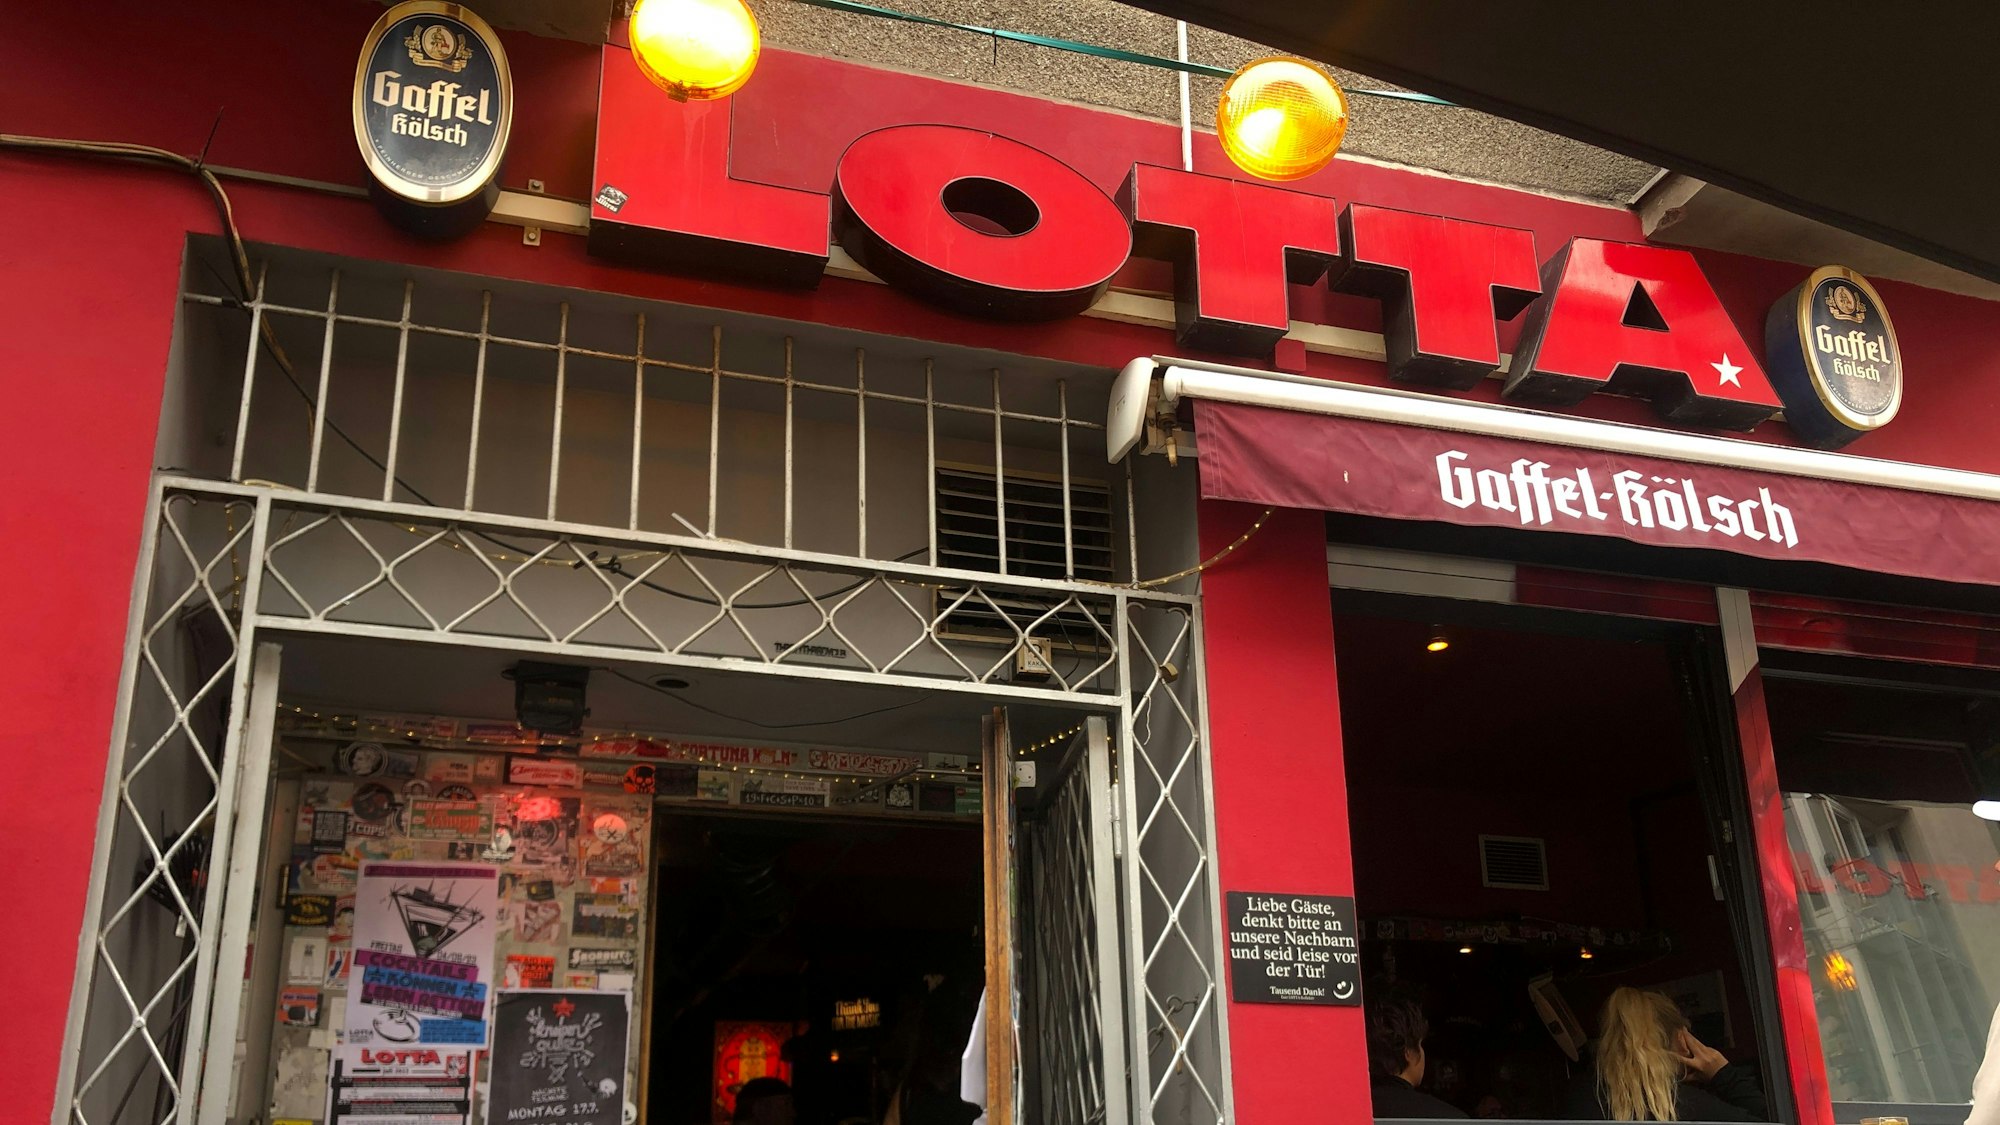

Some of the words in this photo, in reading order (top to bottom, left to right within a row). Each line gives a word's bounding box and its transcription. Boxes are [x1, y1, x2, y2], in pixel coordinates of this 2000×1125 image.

[373, 70, 493, 126] Gaffel
[391, 112, 469, 147] Kölsch
[590, 44, 1783, 410] LOTTA
[1815, 324, 1891, 365] Gaffel
[1832, 357, 1880, 382] Kölsch
[1435, 450, 1799, 549] Gaffel-Kölsch
[1247, 897, 1287, 912] Liebe
[1291, 899, 1335, 917] Gäste,
[1241, 913, 1284, 928] denkt
[1288, 915, 1321, 930] bitte
[1324, 920, 1342, 931] an
[1230, 931, 1280, 944] unsere
[1284, 931, 1355, 948] Nachbarn
[1230, 946, 1260, 960] und
[1264, 946, 1293, 961] seid
[1297, 947, 1330, 962] leise
[1333, 953, 1358, 964] vor
[369, 952, 469, 980] COCKTAILS
[1266, 962, 1291, 977] der
[1294, 963, 1326, 979] Tür!
[1269, 986, 1301, 996] Tausend
[1303, 987, 1325, 997] Dank!
[360, 1047, 441, 1065] LOTTA
[508, 1104, 566, 1121] MONTAG
